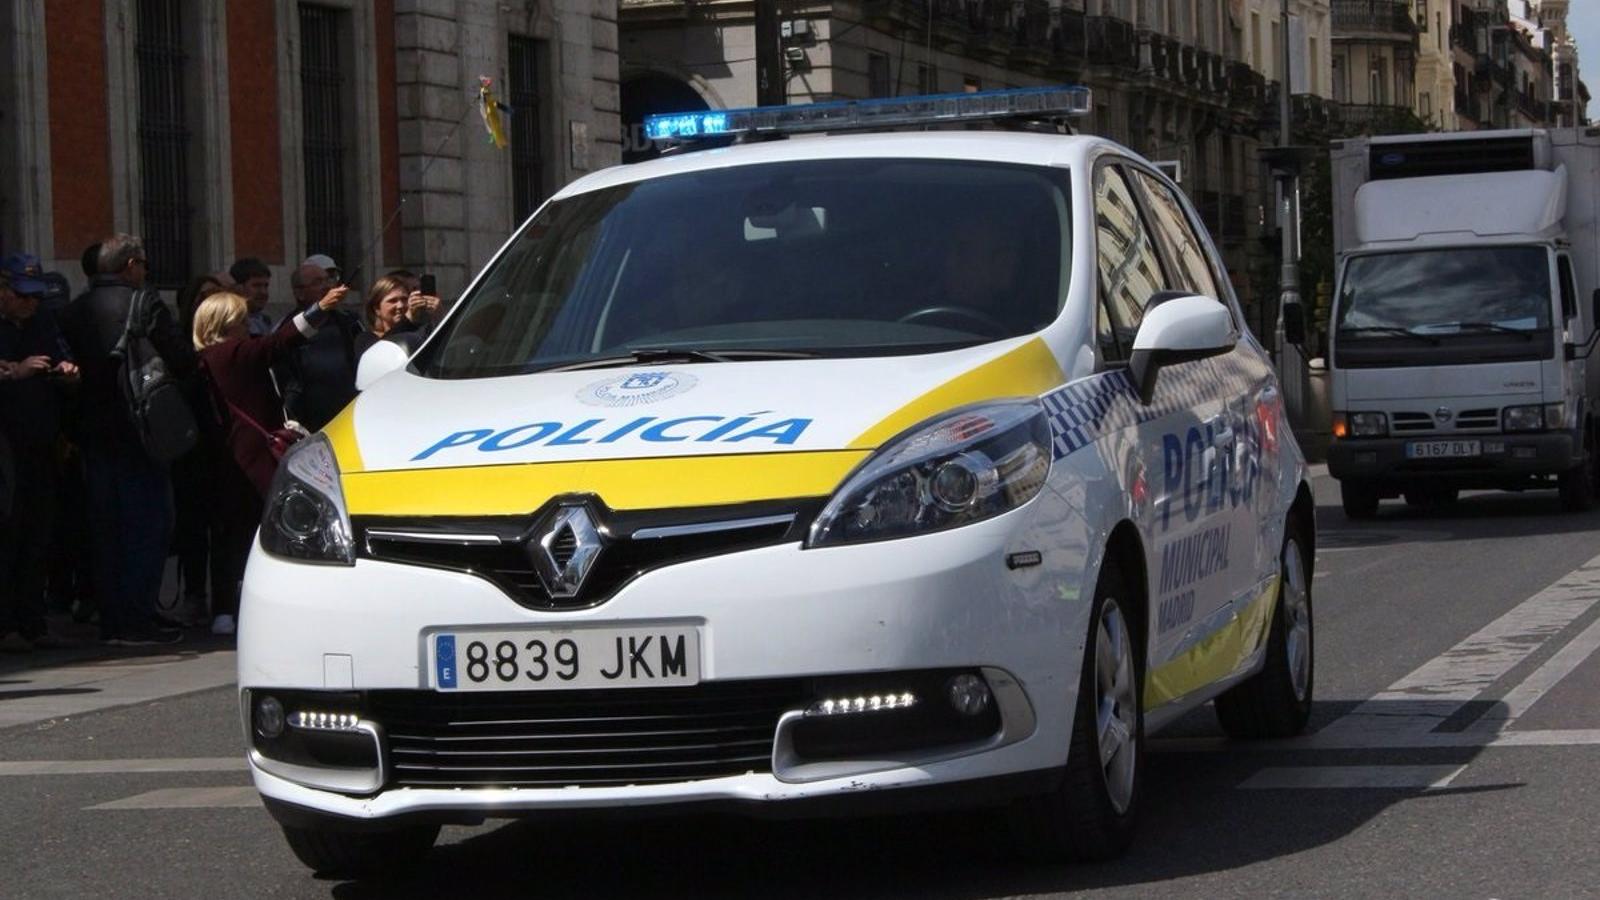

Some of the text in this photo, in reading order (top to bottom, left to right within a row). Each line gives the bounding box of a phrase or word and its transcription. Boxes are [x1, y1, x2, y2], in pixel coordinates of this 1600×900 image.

[408, 410, 813, 462] POLICÍA
[1453, 441, 1475, 453] DLY
[1159, 523, 1232, 596] MUNICIPAL
[1158, 589, 1195, 635] MADRID
[443, 634, 688, 683] E 8839 JKM
